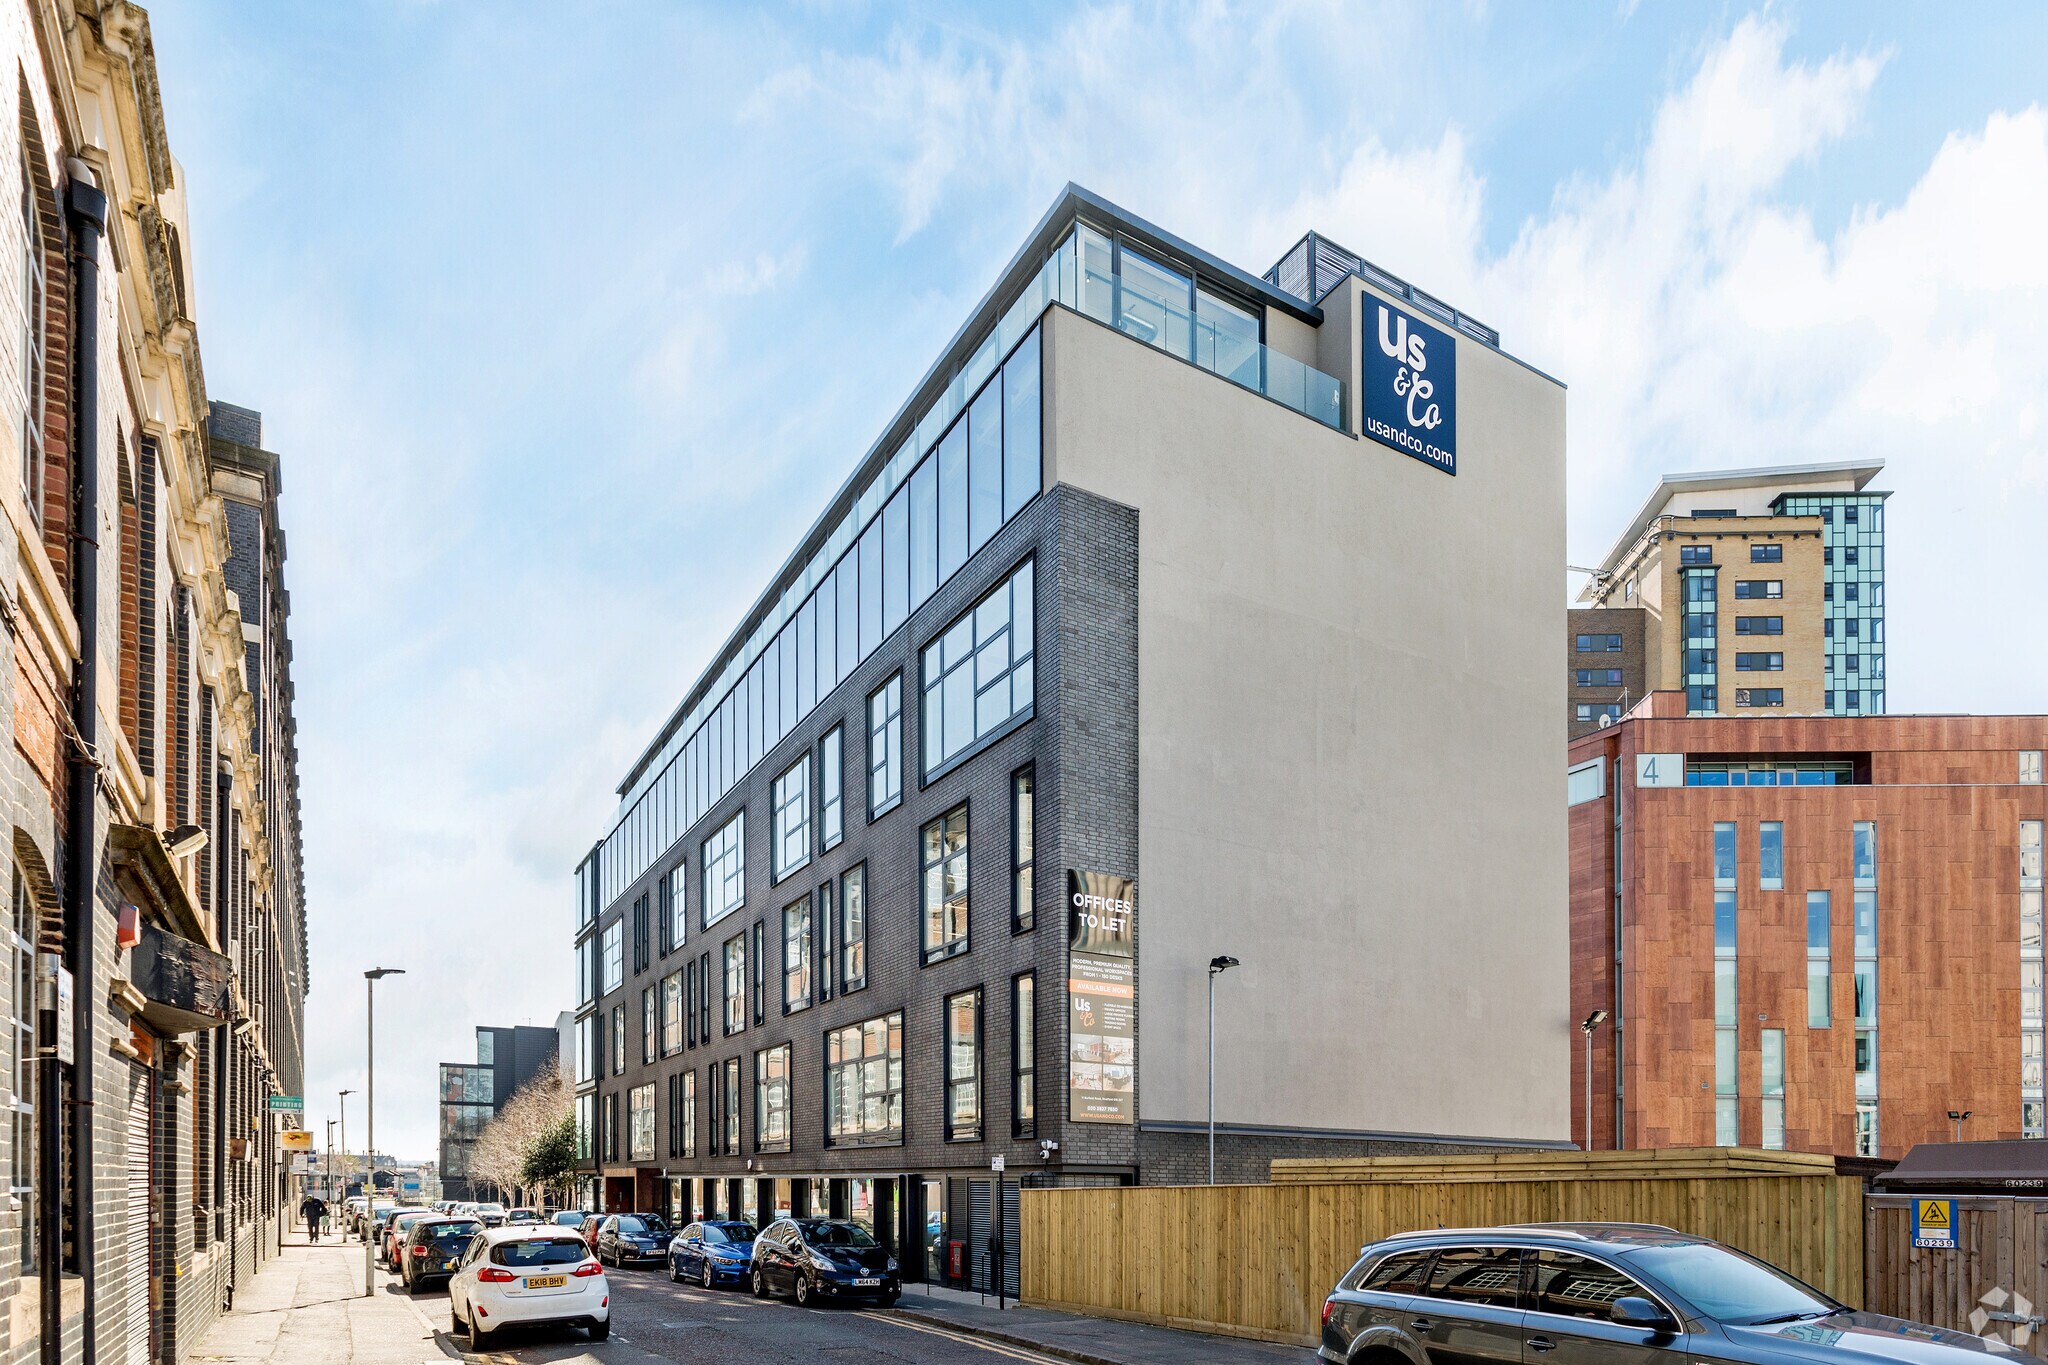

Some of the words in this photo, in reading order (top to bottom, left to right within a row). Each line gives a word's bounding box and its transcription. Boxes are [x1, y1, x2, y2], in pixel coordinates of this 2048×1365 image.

[1393, 366, 1411, 396] &
[1406, 371, 1442, 430] Co
[1367, 416, 1453, 467] usandco.com
[1643, 757, 1659, 784] 4
[1073, 893, 1132, 914] OFFICES
[1078, 913, 1098, 928] TO
[1101, 916, 1126, 933] LET
[1071, 964, 1104, 972] PROFESSIONAL
[1077, 983, 1111, 993] AVAILABLE
[1074, 997, 1091, 1012] Us
[1083, 1011, 1096, 1027] Co
[1916, 1239, 1953, 1247] 60239
[529, 1277, 547, 1287] EK18
[549, 1276, 564, 1285] BHV
